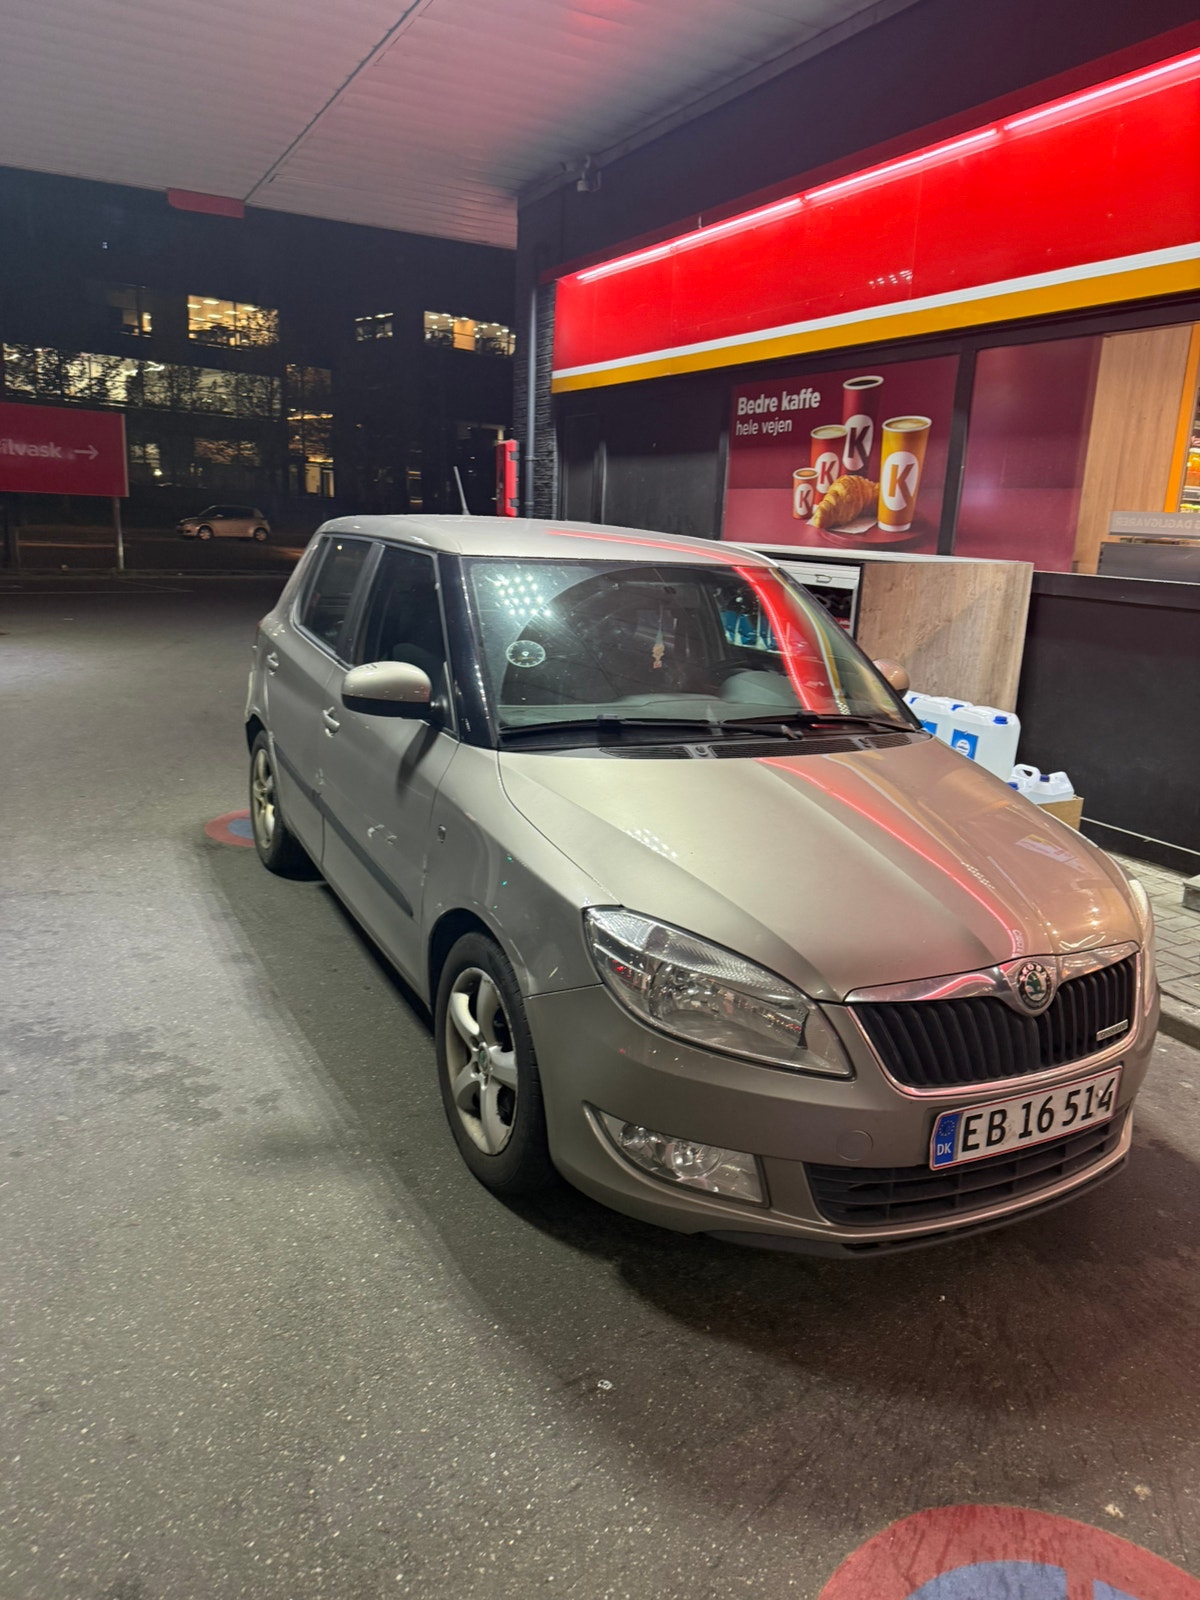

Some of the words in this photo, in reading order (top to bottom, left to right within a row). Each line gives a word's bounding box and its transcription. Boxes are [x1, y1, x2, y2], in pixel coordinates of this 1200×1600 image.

[737, 393, 778, 415] Bedre
[781, 387, 821, 411] kaffe
[736, 419, 759, 436] hele
[761, 417, 793, 436] vejen
[0, 438, 63, 459] ilvask
[847, 424, 871, 466] K
[820, 460, 838, 488] K
[888, 462, 915, 504] K
[798, 489, 812, 514] K
[961, 1108, 1007, 1153] EB
[1018, 1095, 1054, 1139] 16
[1062, 1077, 1116, 1127] 514
[936, 1141, 952, 1156] DK
